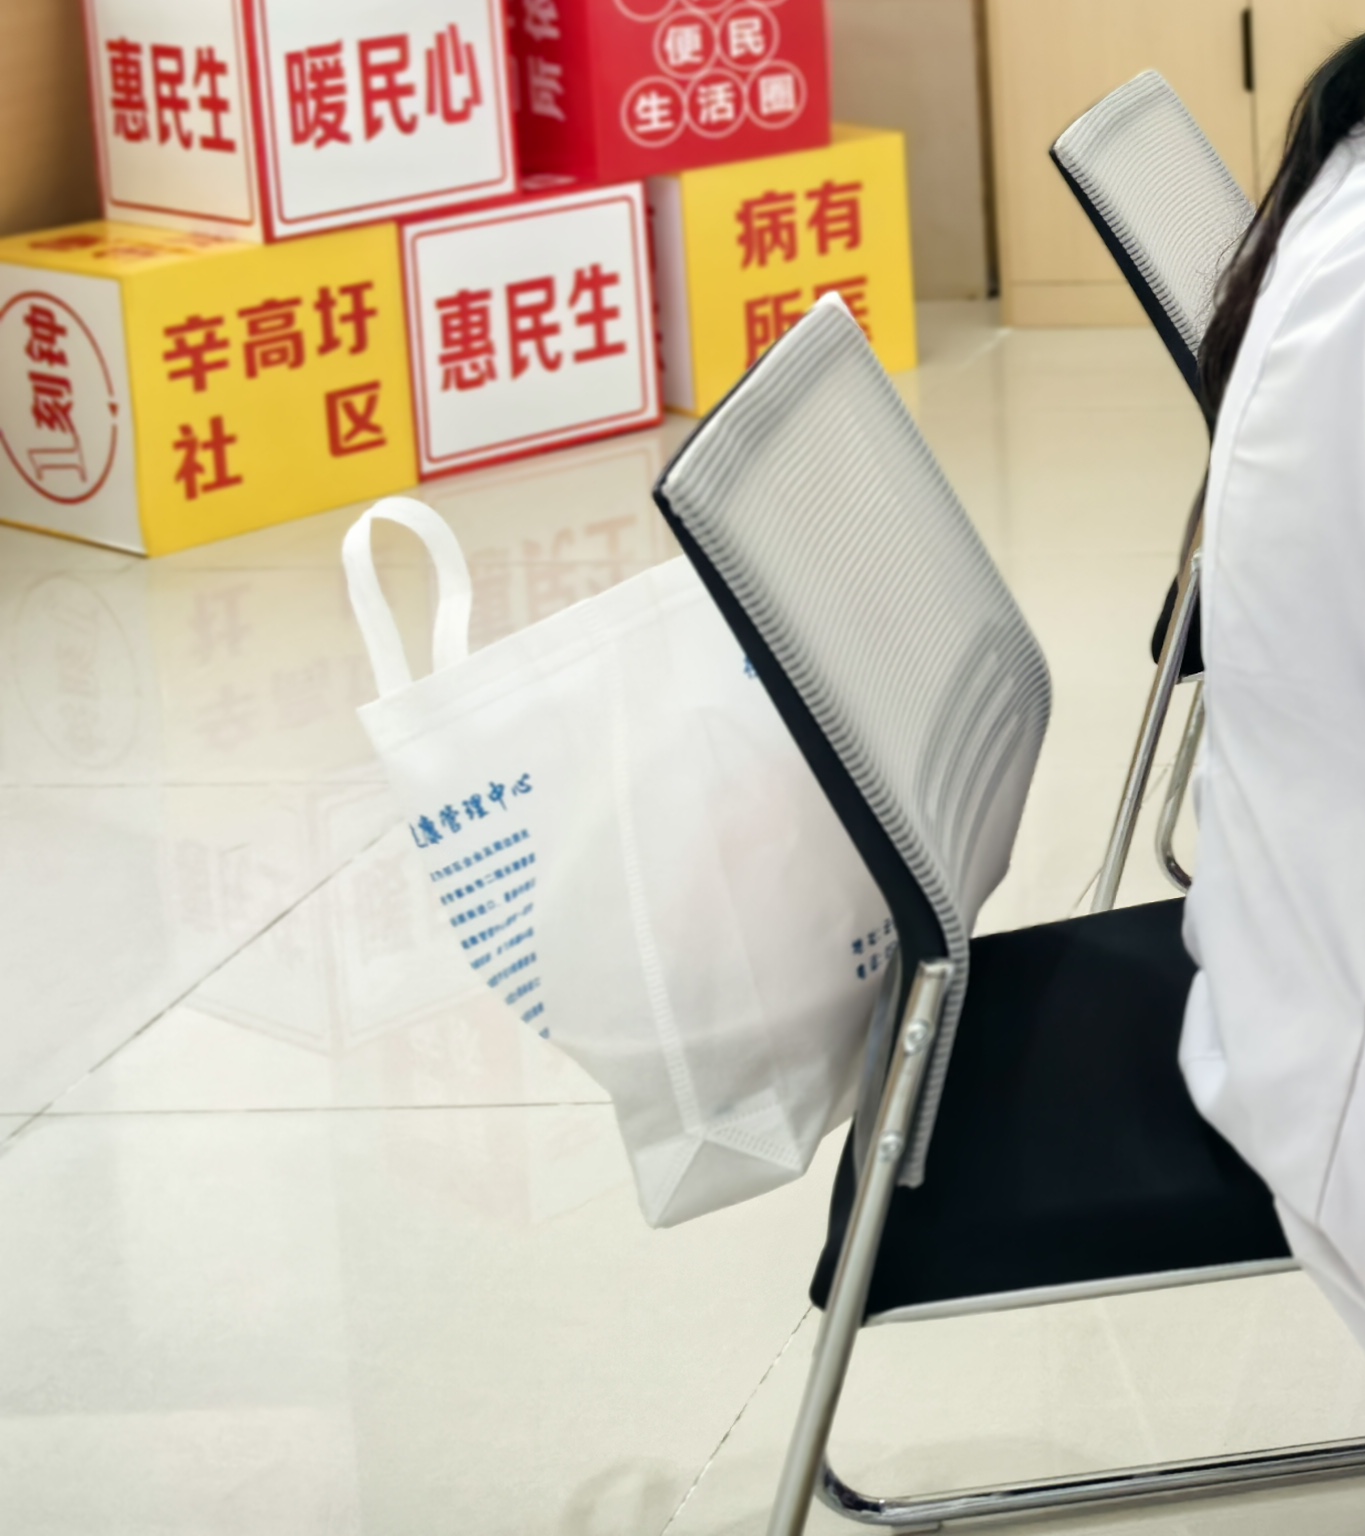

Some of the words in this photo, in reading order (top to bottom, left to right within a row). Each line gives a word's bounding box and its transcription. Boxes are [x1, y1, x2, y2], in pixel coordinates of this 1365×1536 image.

[106, 37, 237, 154] 惠民生
[285, 22, 484, 151] 暖民心
[663, 16, 765, 68] 便民
[634, 72, 797, 133] 生活圈
[735, 178, 863, 271] 病有
[162, 280, 379, 394] 辛高圩
[434, 263, 628, 392] 惠民生
